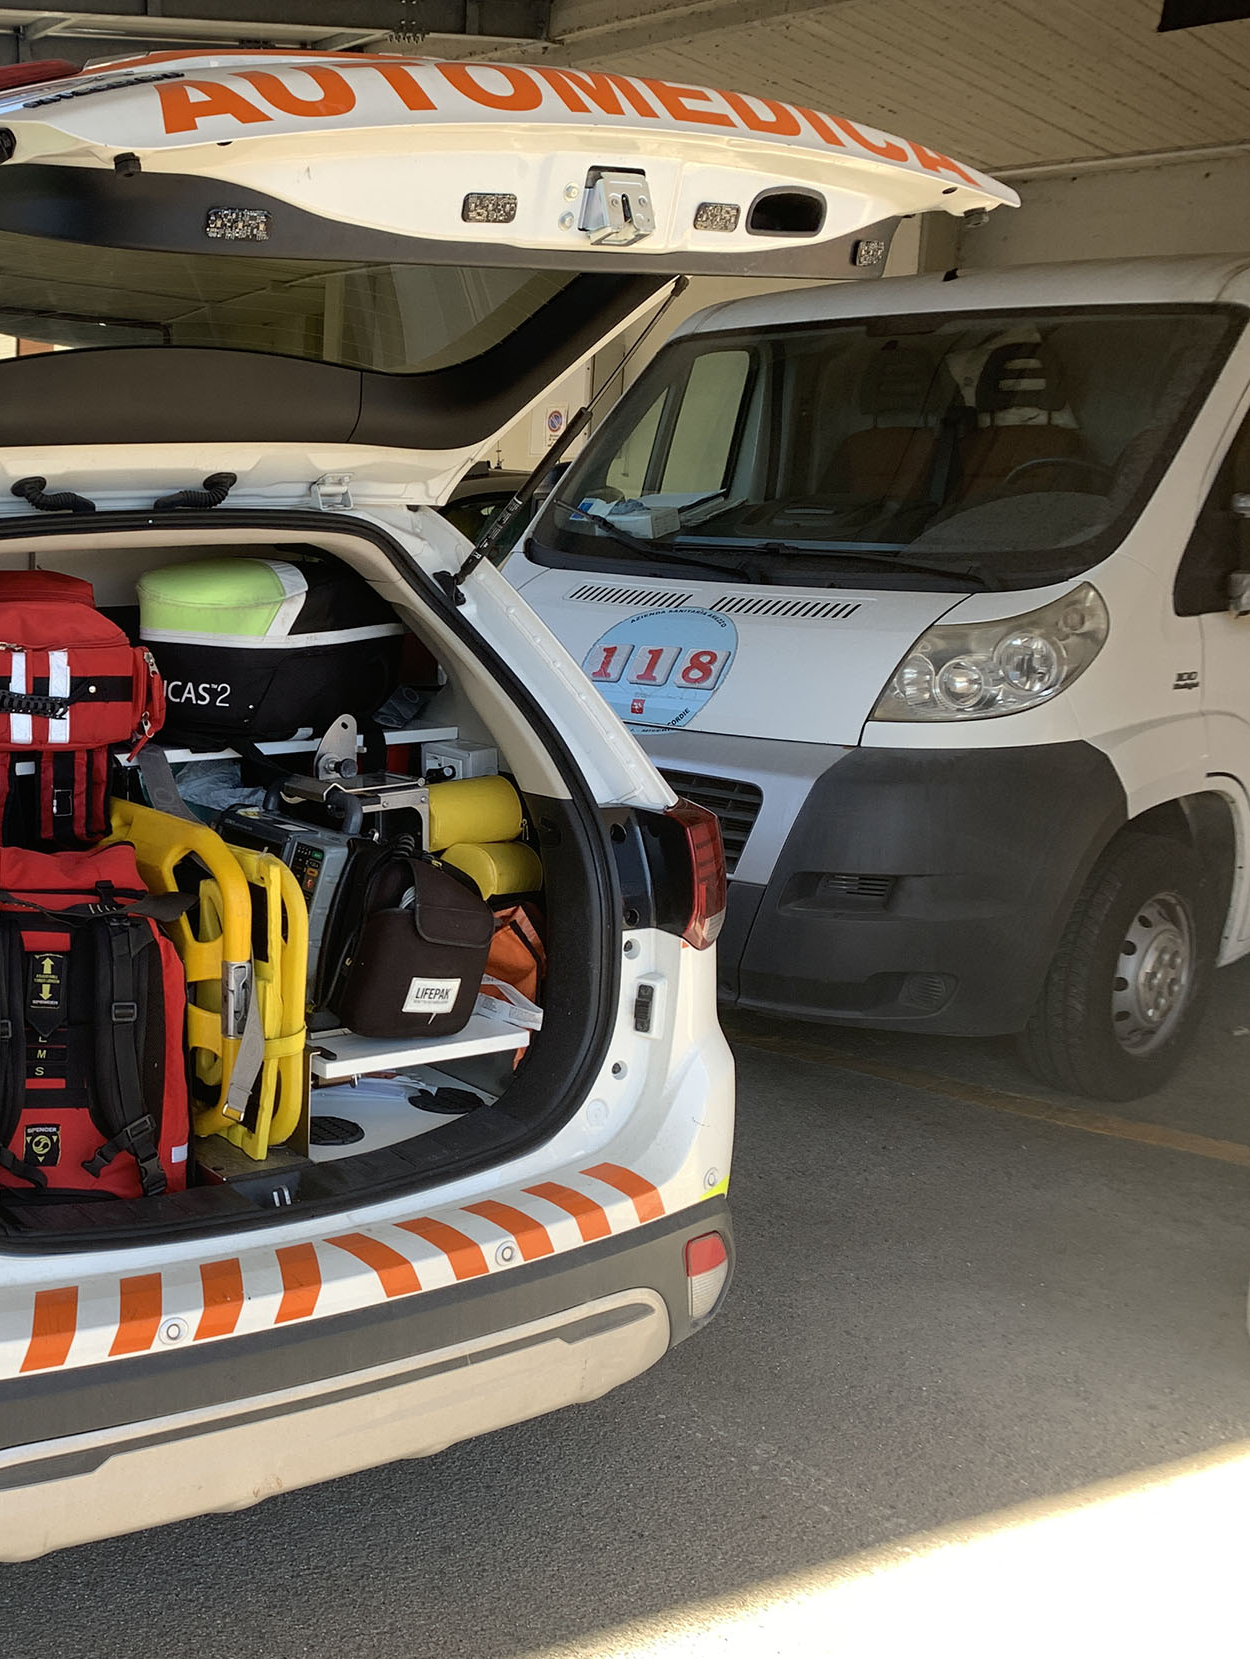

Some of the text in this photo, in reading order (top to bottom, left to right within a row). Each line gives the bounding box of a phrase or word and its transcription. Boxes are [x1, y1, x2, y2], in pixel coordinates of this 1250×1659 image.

[155, 61, 979, 187] AUTOMEDICA
[631, 610, 666, 623] AZIENDA
[707, 612, 727, 628] AREZZO
[592, 646, 718, 684] 118
[415, 987, 450, 1000] LIFEPAK
[37, 1050, 47, 1059] M
[34, 1067, 45, 1076] S
